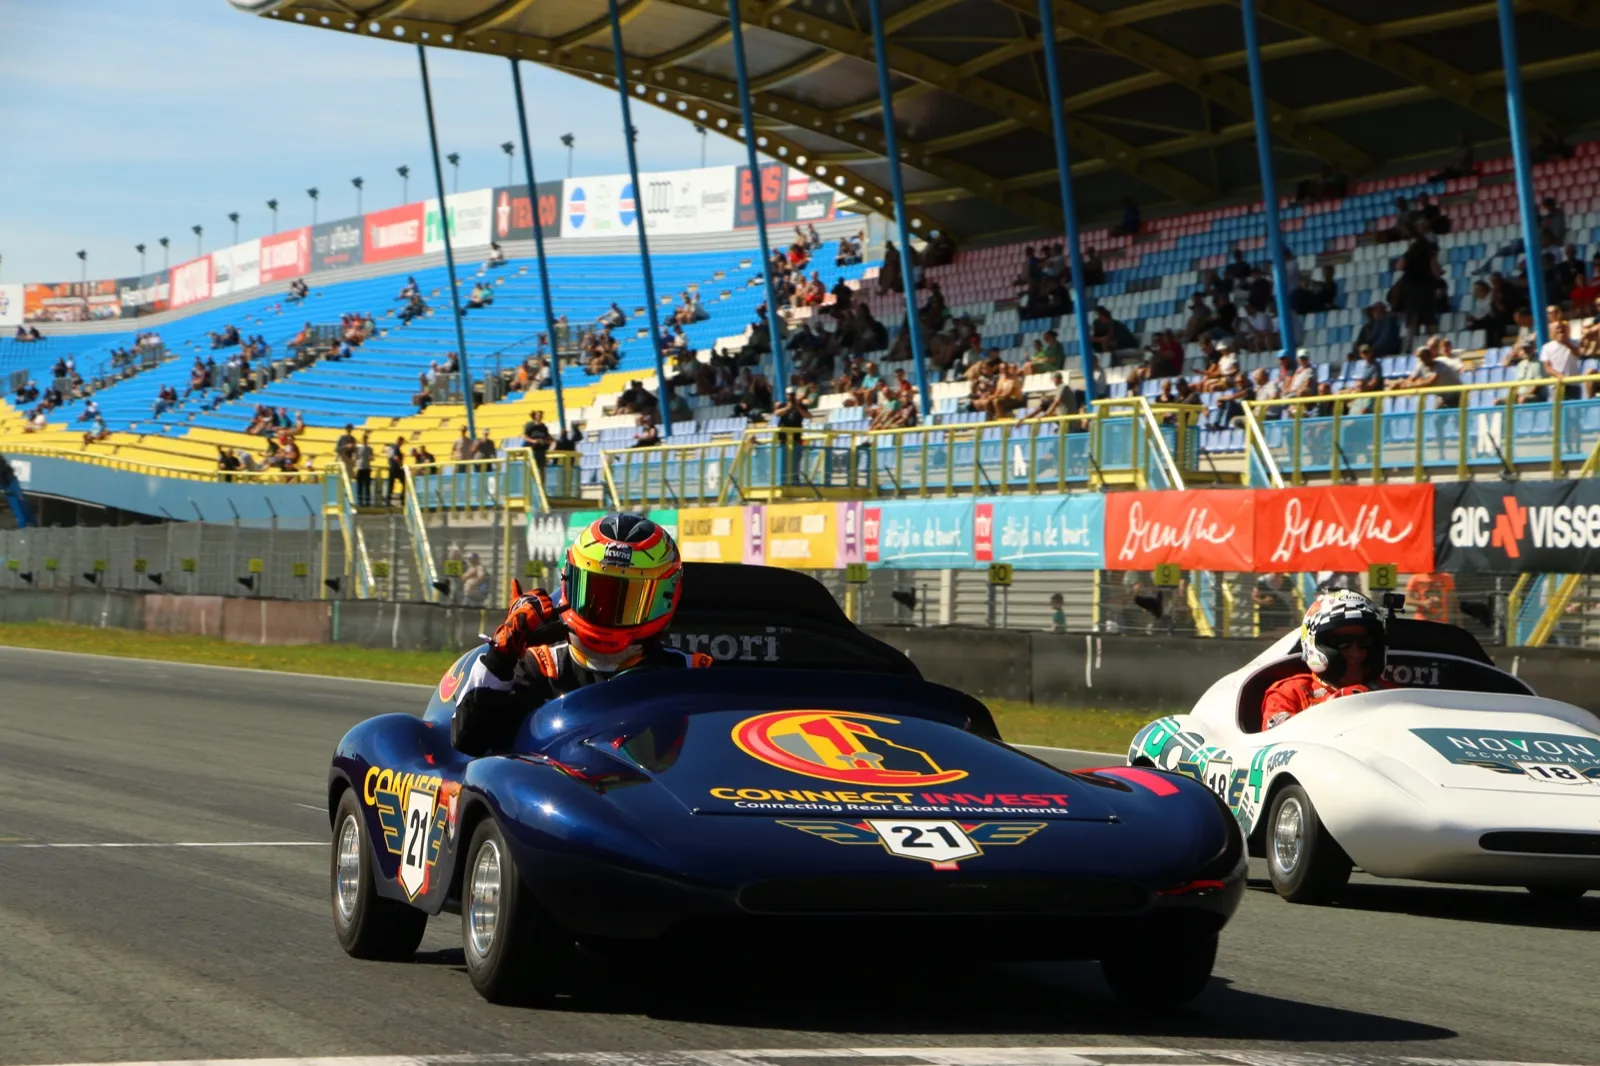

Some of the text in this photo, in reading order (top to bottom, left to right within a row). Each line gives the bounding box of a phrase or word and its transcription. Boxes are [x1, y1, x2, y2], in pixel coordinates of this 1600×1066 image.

[1118, 500, 1236, 561] Drenthe
[1271, 498, 1413, 562] Drenthe
[1376, 566, 1389, 586] 8
[1384, 662, 1440, 685] rori
[1446, 736, 1595, 757] NOVON
[1528, 766, 1577, 780] 18
[709, 787, 1068, 806] CONNECT INVEST
[1209, 772, 1227, 804] 18
[734, 801, 843, 812] Connecting
[893, 804, 951, 812] Estate
[955, 805, 1068, 814] Investments
[407, 808, 428, 869] 21
[891, 826, 961, 848] 21
